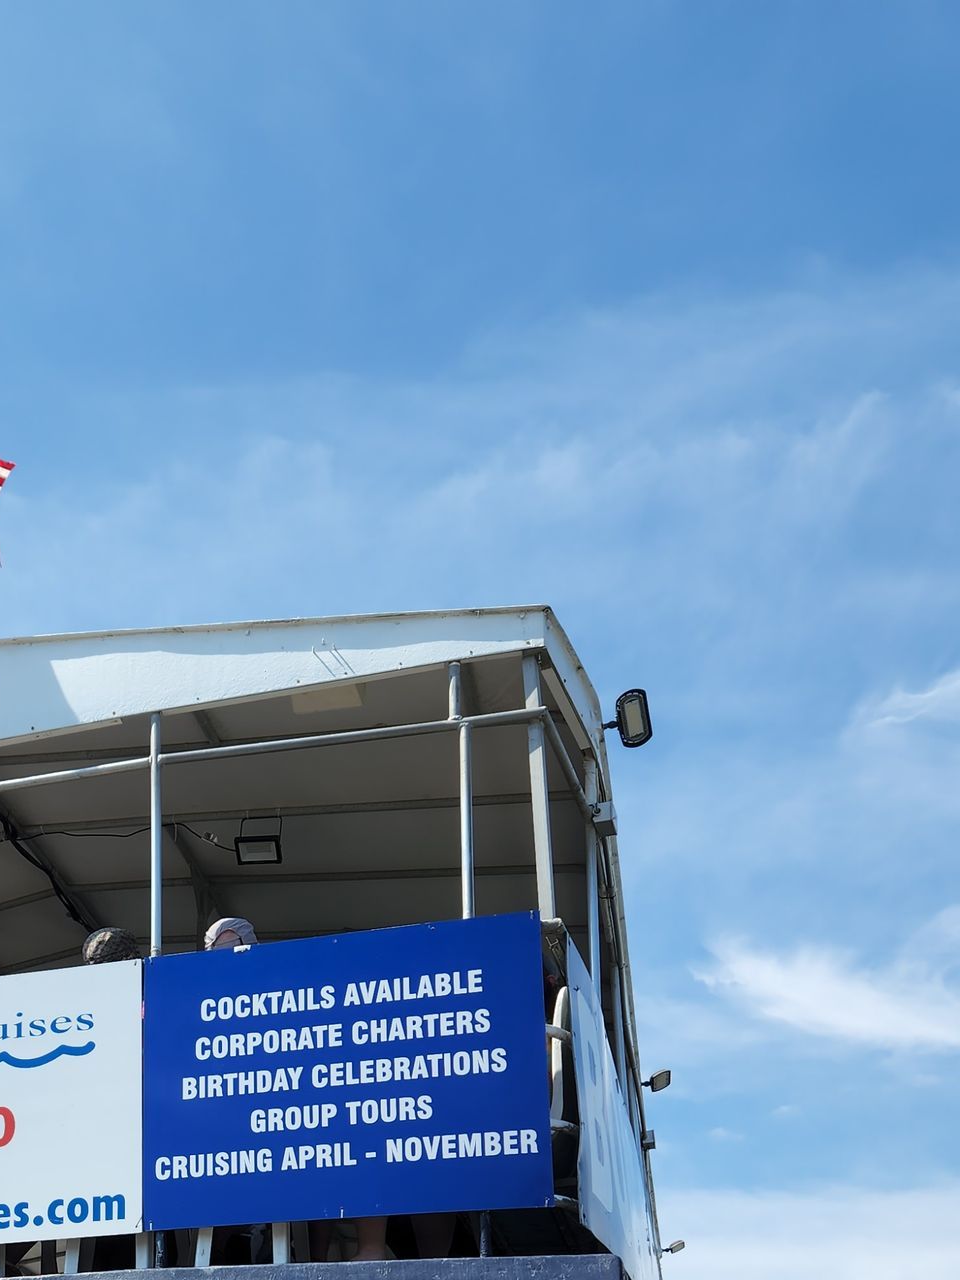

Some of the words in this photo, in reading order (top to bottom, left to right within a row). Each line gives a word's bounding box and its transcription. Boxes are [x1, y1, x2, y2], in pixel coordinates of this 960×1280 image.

[200, 984, 335, 1022] COCKTAILS
[344, 969, 483, 1007] AVAILABLE
[195, 1023, 342, 1061] CORPORATE
[351, 1008, 491, 1045] CHARTERS
[182, 1066, 304, 1100] BIRTHDAY
[311, 1047, 507, 1089] CELEBRATIONS
[250, 1103, 337, 1133] GROUP
[345, 1095, 433, 1125] TOURS
[155, 1148, 272, 1181] CRUISING
[281, 1142, 357, 1170] APRIL
[386, 1128, 538, 1163] NOVEMBER
